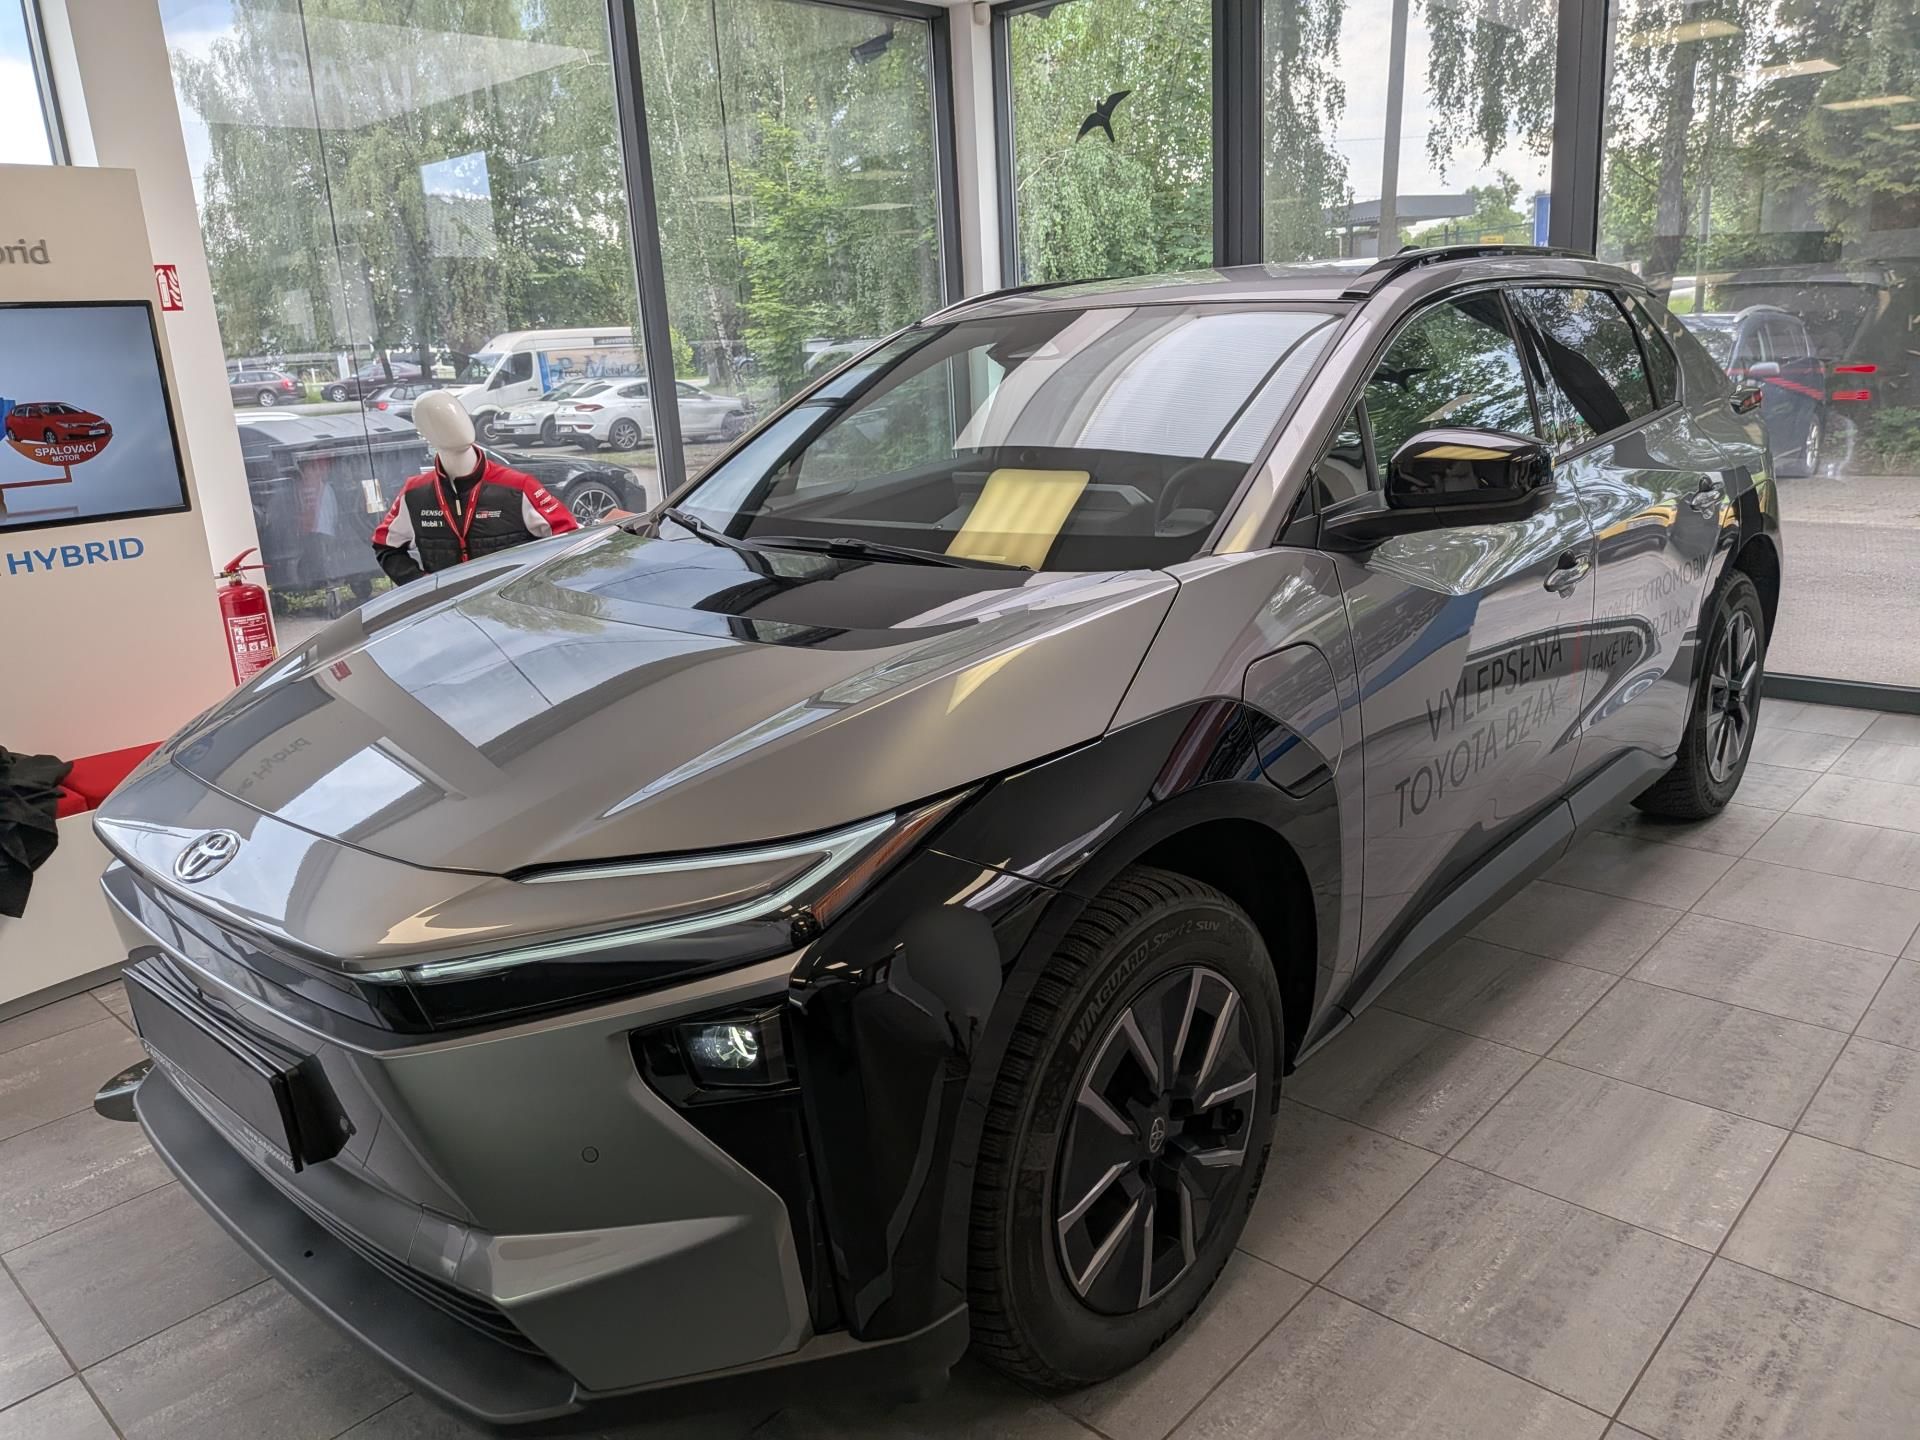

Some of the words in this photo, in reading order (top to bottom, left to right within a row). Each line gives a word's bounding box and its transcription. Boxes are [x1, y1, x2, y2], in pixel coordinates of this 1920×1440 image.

[34, 441, 97, 457] SPALOVACÍ
[52, 454, 80, 463] MOTOR
[420, 509, 444, 517] DENSO
[421, 520, 438, 528] Mobil
[6, 537, 145, 576] HYBRID
[1394, 720, 1498, 828] TOYOTA
[1068, 938, 1150, 1052] WINGUARD
[1196, 920, 1220, 931] SUV
